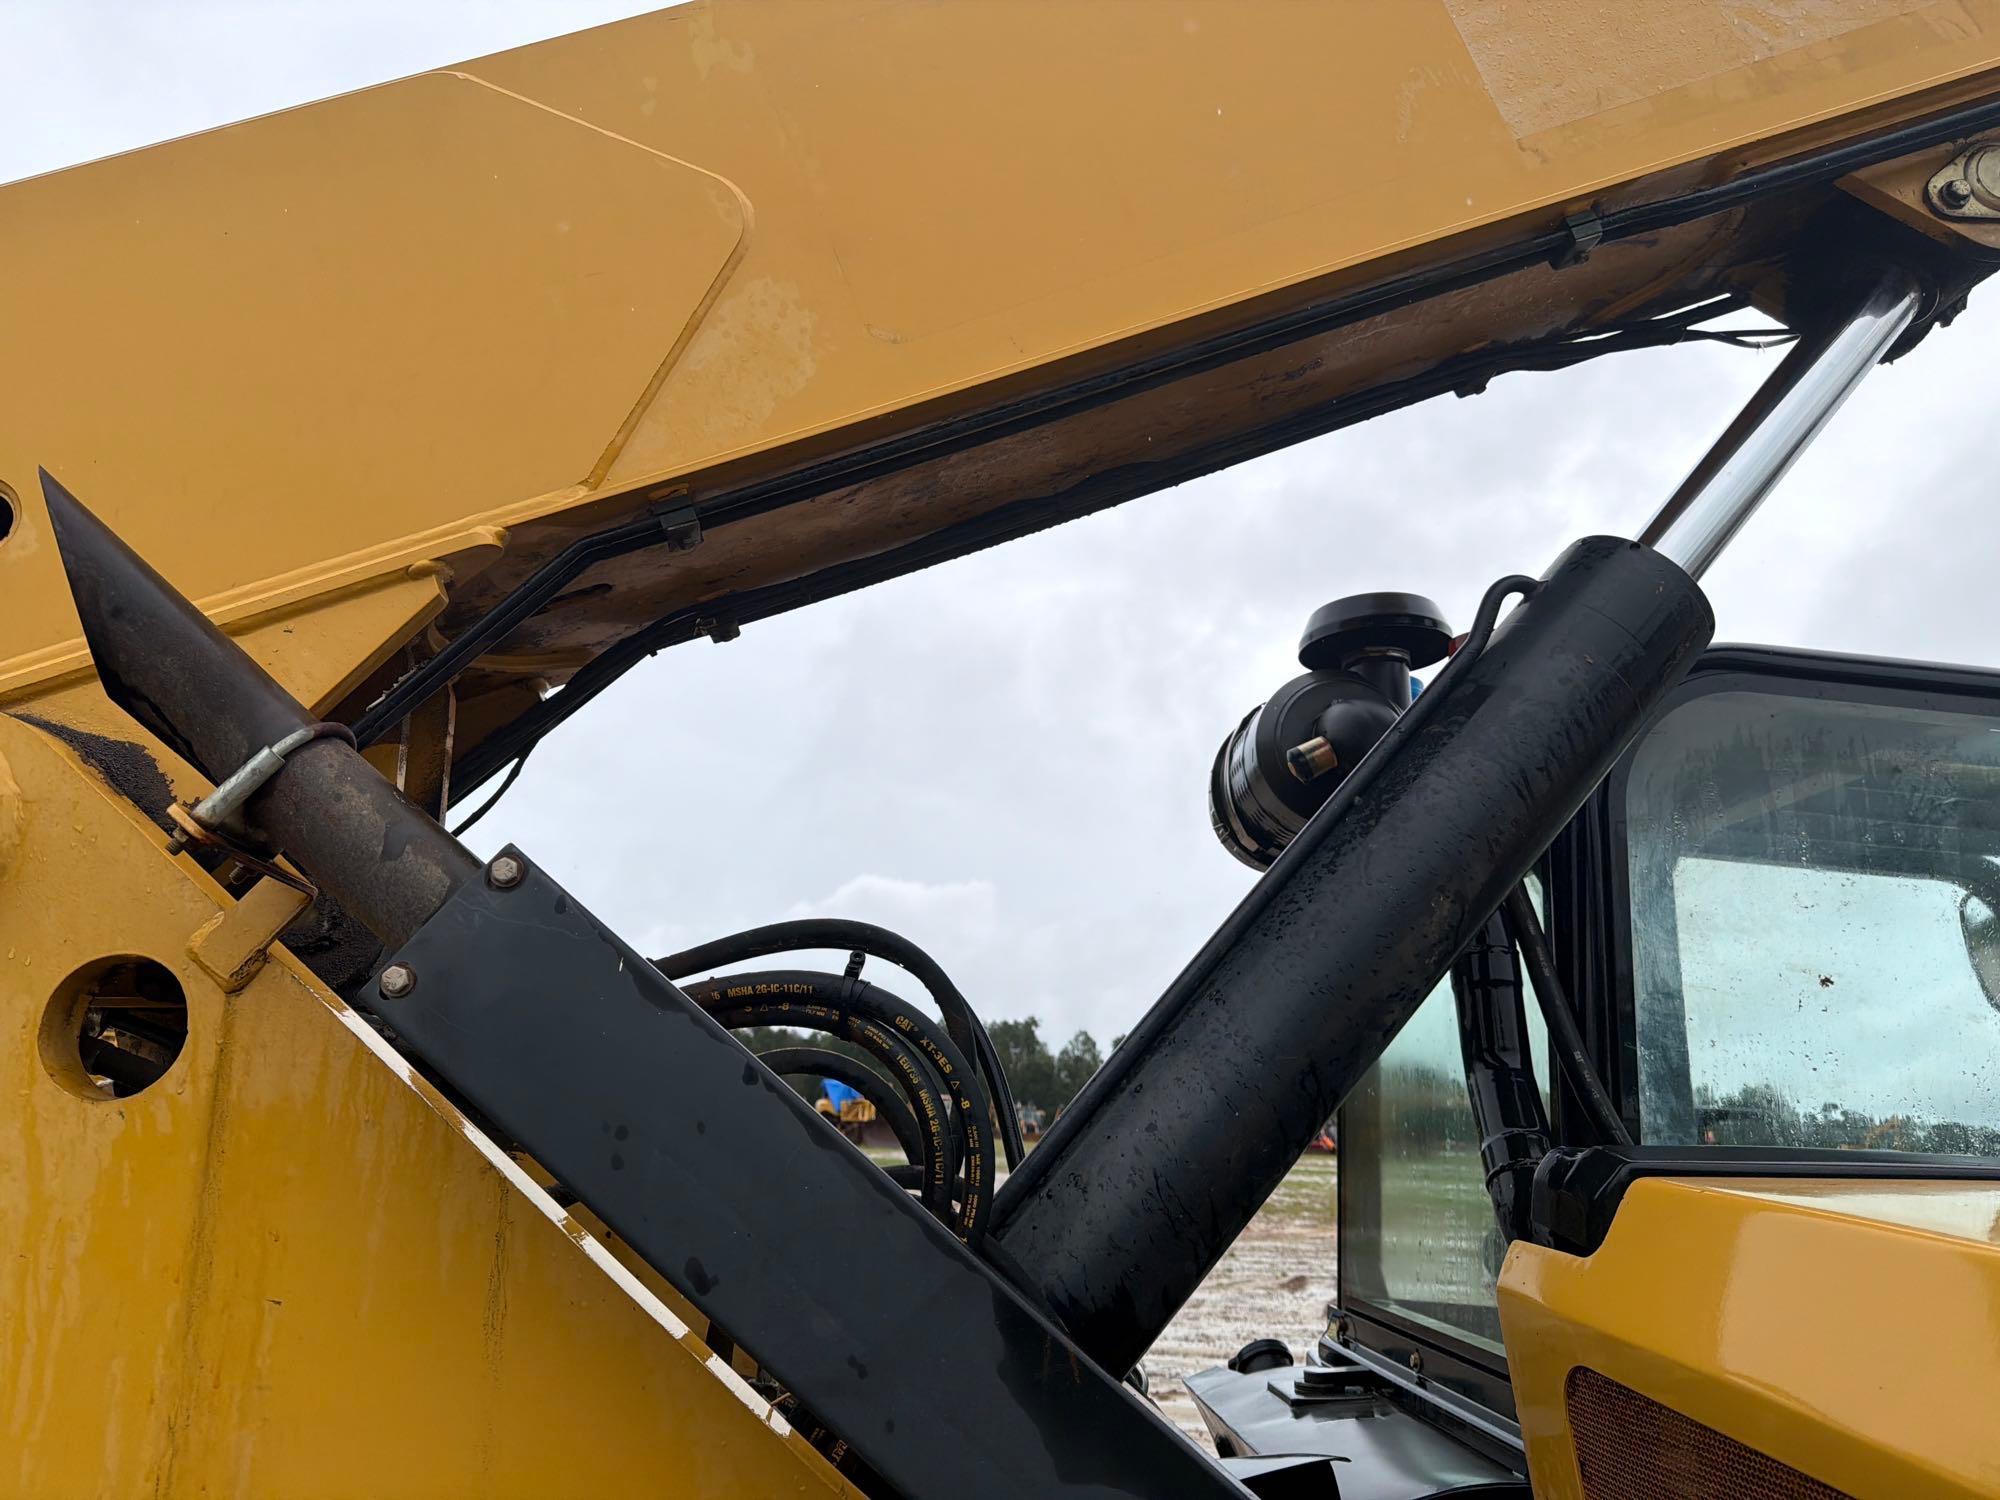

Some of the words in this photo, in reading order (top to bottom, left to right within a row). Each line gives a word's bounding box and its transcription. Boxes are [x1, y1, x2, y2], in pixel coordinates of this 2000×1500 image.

[727, 986, 754, 998] MSHA
[755, 983, 813, 995] 2G-IC-11C/11
[895, 1015, 914, 1031] CAT
[920, 1036, 953, 1074] XT-3ES
[919, 1088, 936, 1118] MSHA
[930, 1118, 944, 1184] 2G-IC-11C/11
